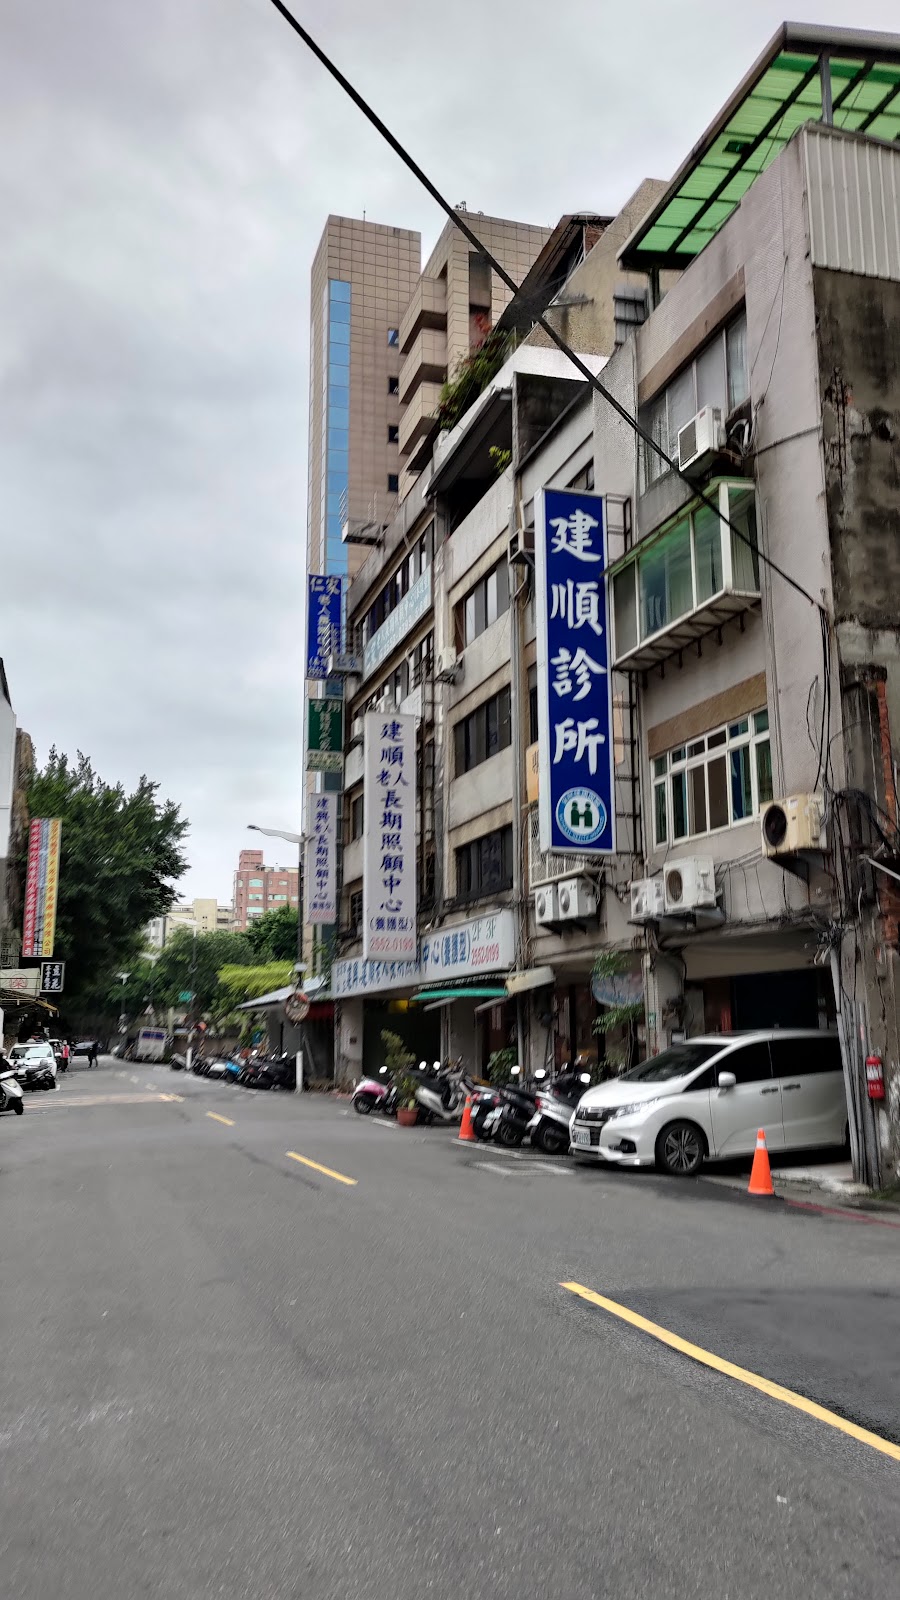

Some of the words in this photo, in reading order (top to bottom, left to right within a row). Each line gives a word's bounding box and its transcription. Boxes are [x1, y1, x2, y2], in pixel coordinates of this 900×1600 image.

[549, 508, 607, 776] 建順診所
[376, 719, 409, 913] 建順老人長期照顧中心
